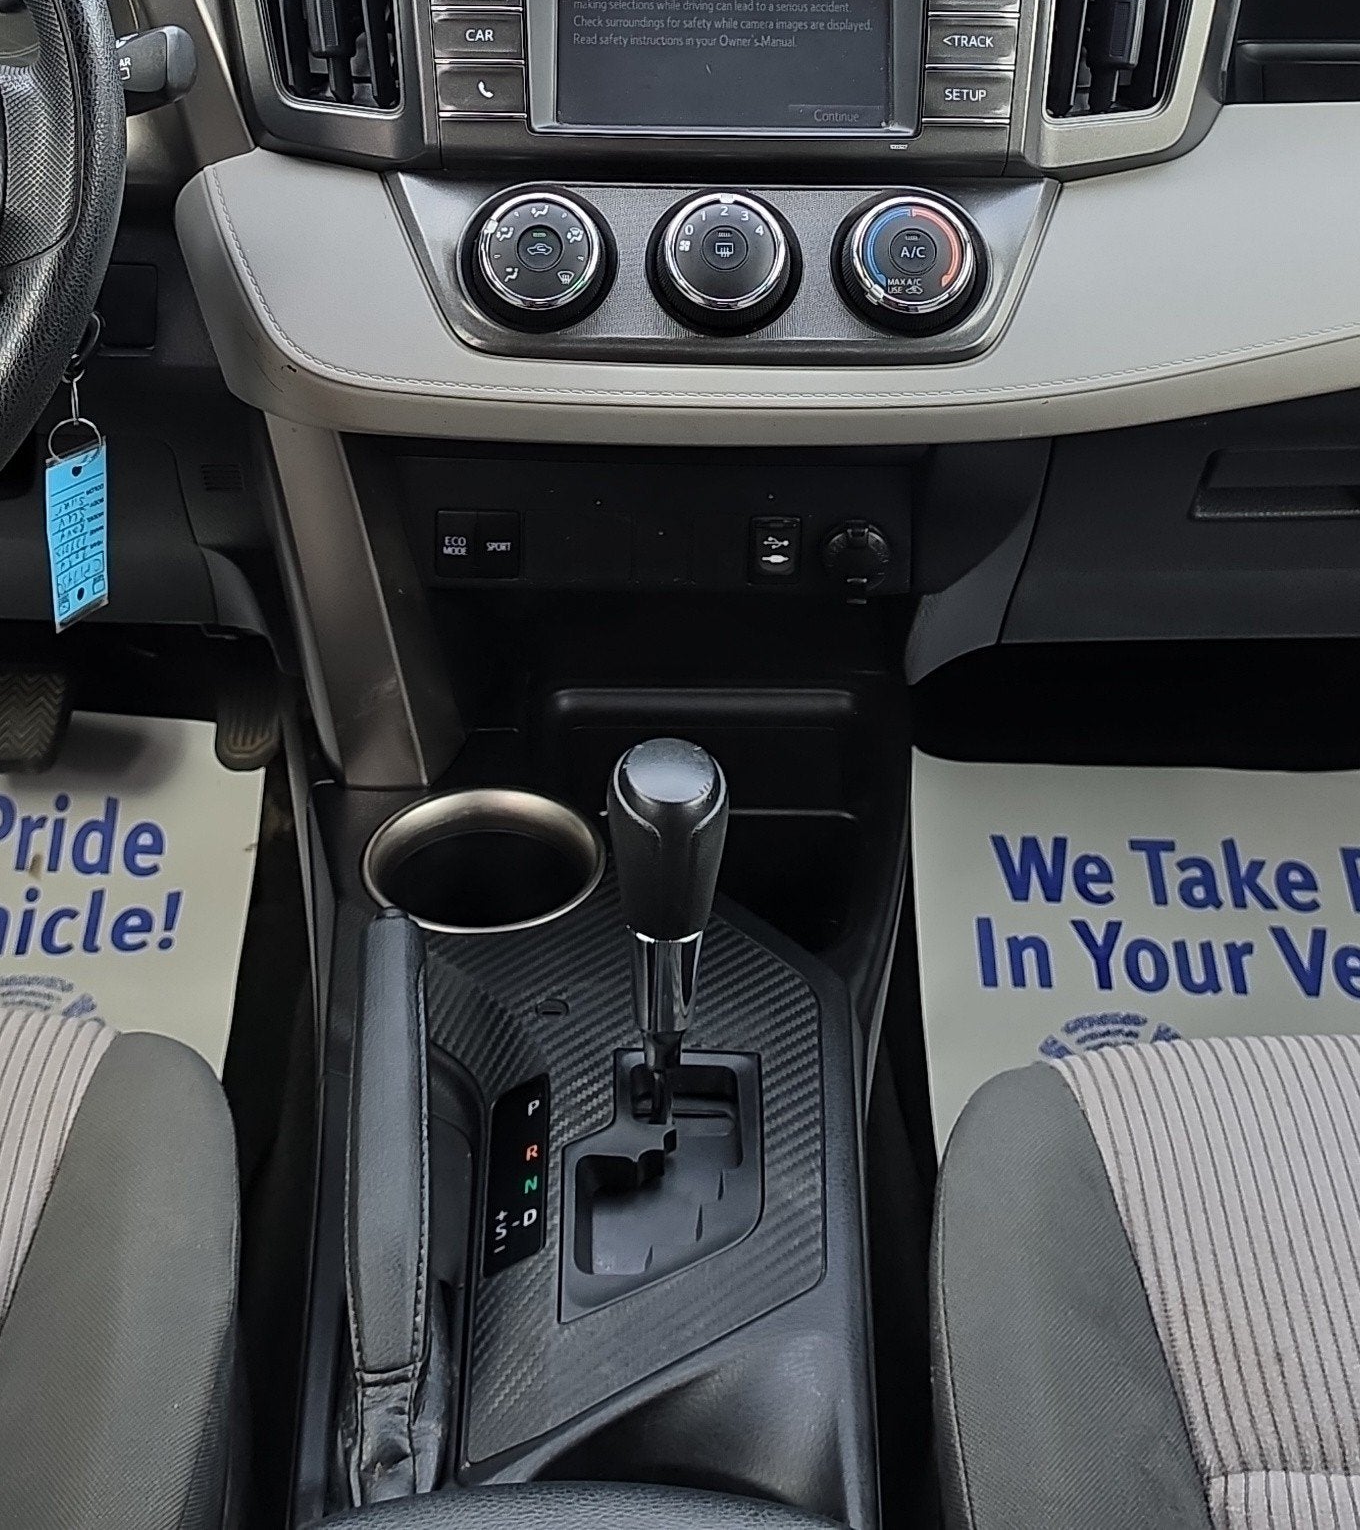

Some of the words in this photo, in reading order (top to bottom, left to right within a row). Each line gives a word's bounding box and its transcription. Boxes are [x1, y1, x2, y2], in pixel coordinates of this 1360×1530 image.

[573, 0, 607, 12] making
[610, 0, 654, 11] selections
[656, 0, 681, 11] while
[683, 0, 714, 13] driving
[715, 2, 733, 11] can
[734, 0, 754, 12] lead
[756, 2, 767, 12] to
[776, 1, 808, 12] serious
[573, 15, 604, 28] Check
[605, 16, 665, 30] surroundings
[666, 16, 681, 28] for
[683, 17, 712, 31] safety
[714, 18, 738, 30] while
[740, 20, 774, 30] camera
[776, 18, 808, 32] images
[810, 21, 825, 31] are
[465, 29, 495, 42] CAR
[573, 33, 598, 46] Read
[599, 33, 628, 48] safety
[630, 34, 684, 47] instructions
[685, 35, 694, 46] in
[695, 37, 717, 49] your
[719, 34, 760, 48] Owner's
[944, 88, 987, 102] SETUP
[814, 109, 860, 122] Continue
[701, 210, 707, 222] 1
[720, 205, 729, 216] 2
[741, 210, 750, 221] 3
[684, 224, 694, 236] 0
[755, 225, 765, 236] 4
[900, 246, 926, 258] A/C
[887, 278, 906, 286] MAX
[906, 278, 922, 286] A/C
[887, 286, 903, 295] USE
[444, 536, 467, 547] ECO
[485, 541, 512, 552] SPORT
[443, 546, 468, 556] MODE
[988, 832, 1116, 906] We
[1128, 836, 1321, 914] Take
[975, 916, 1053, 990] In
[1069, 919, 1254, 994] Your
[527, 1099, 540, 1117] P
[525, 1144, 539, 1162] R
[524, 1175, 539, 1194] N
[495, 1223, 508, 1240] S
[522, 1208, 537, 1227] D
